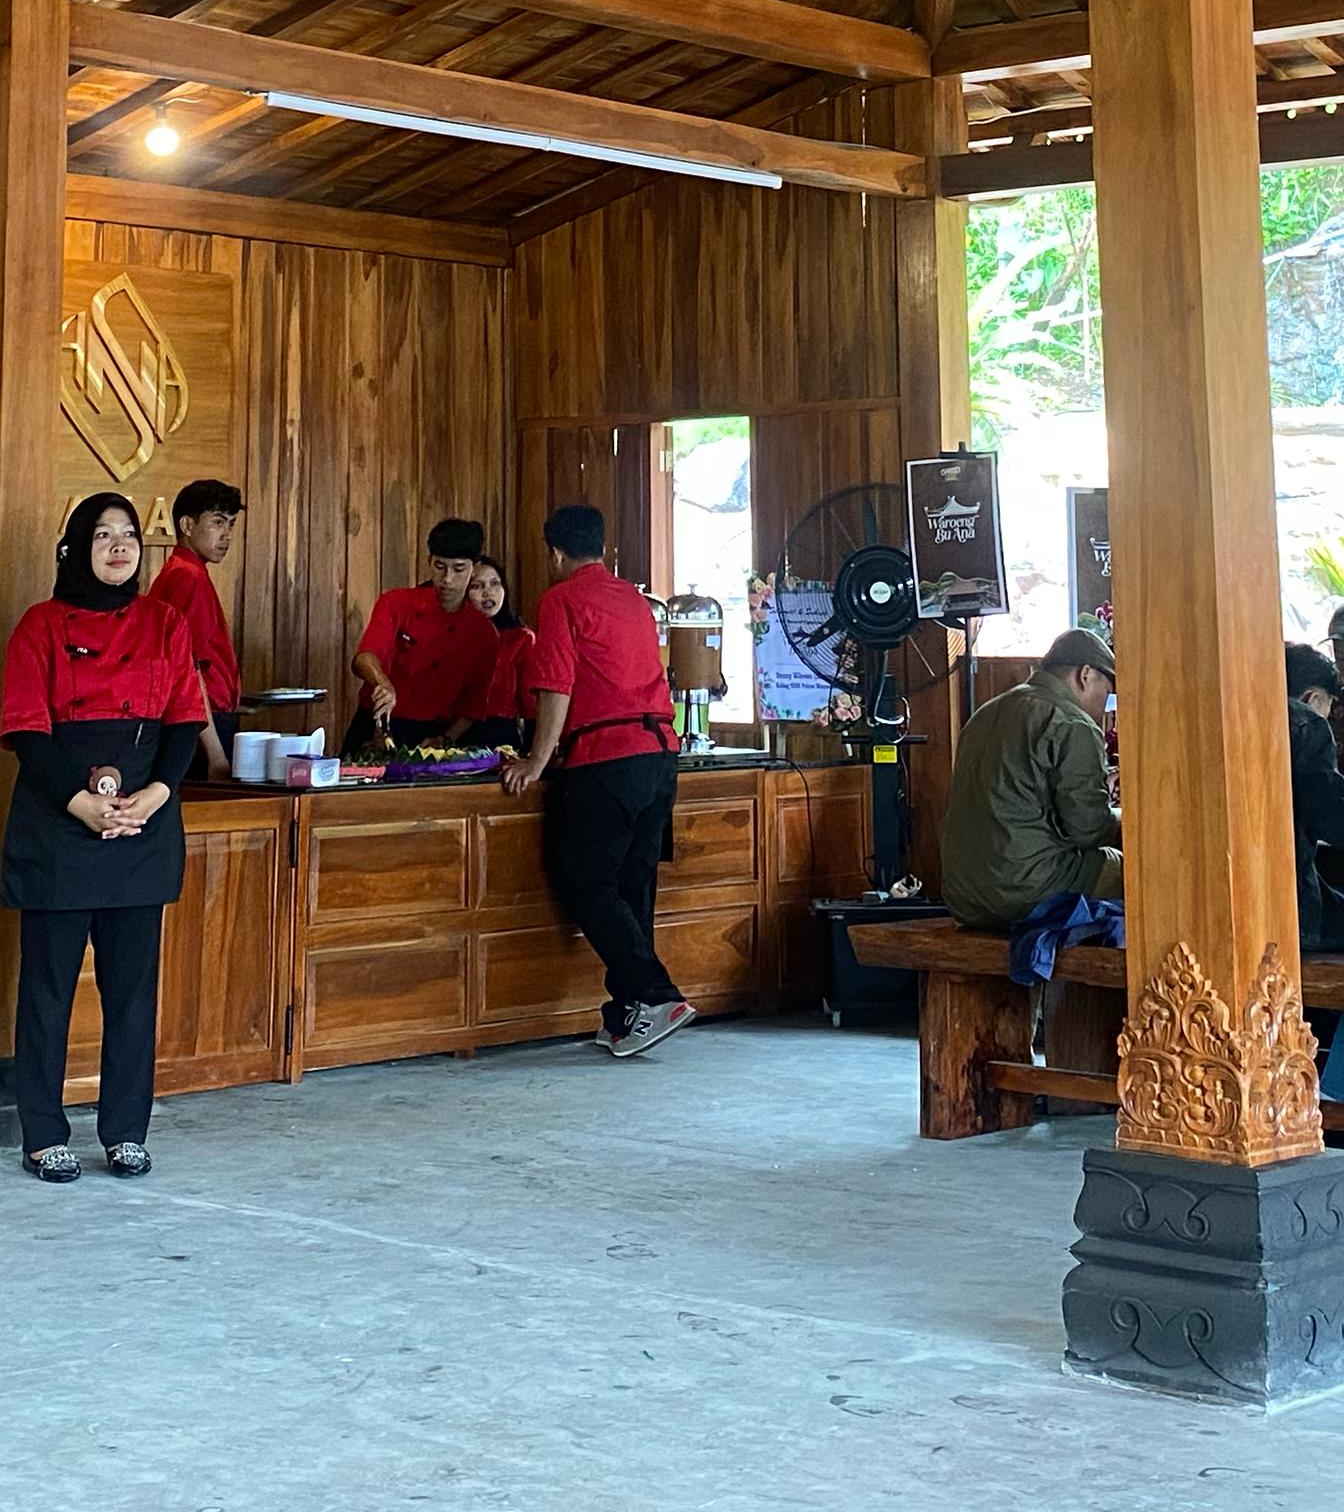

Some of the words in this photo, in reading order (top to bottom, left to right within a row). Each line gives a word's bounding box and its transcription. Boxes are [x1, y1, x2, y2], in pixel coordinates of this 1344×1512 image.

[928, 516, 979, 529] Waroeng
[935, 528, 952, 544] Bu
[953, 527, 975, 543] Ana
